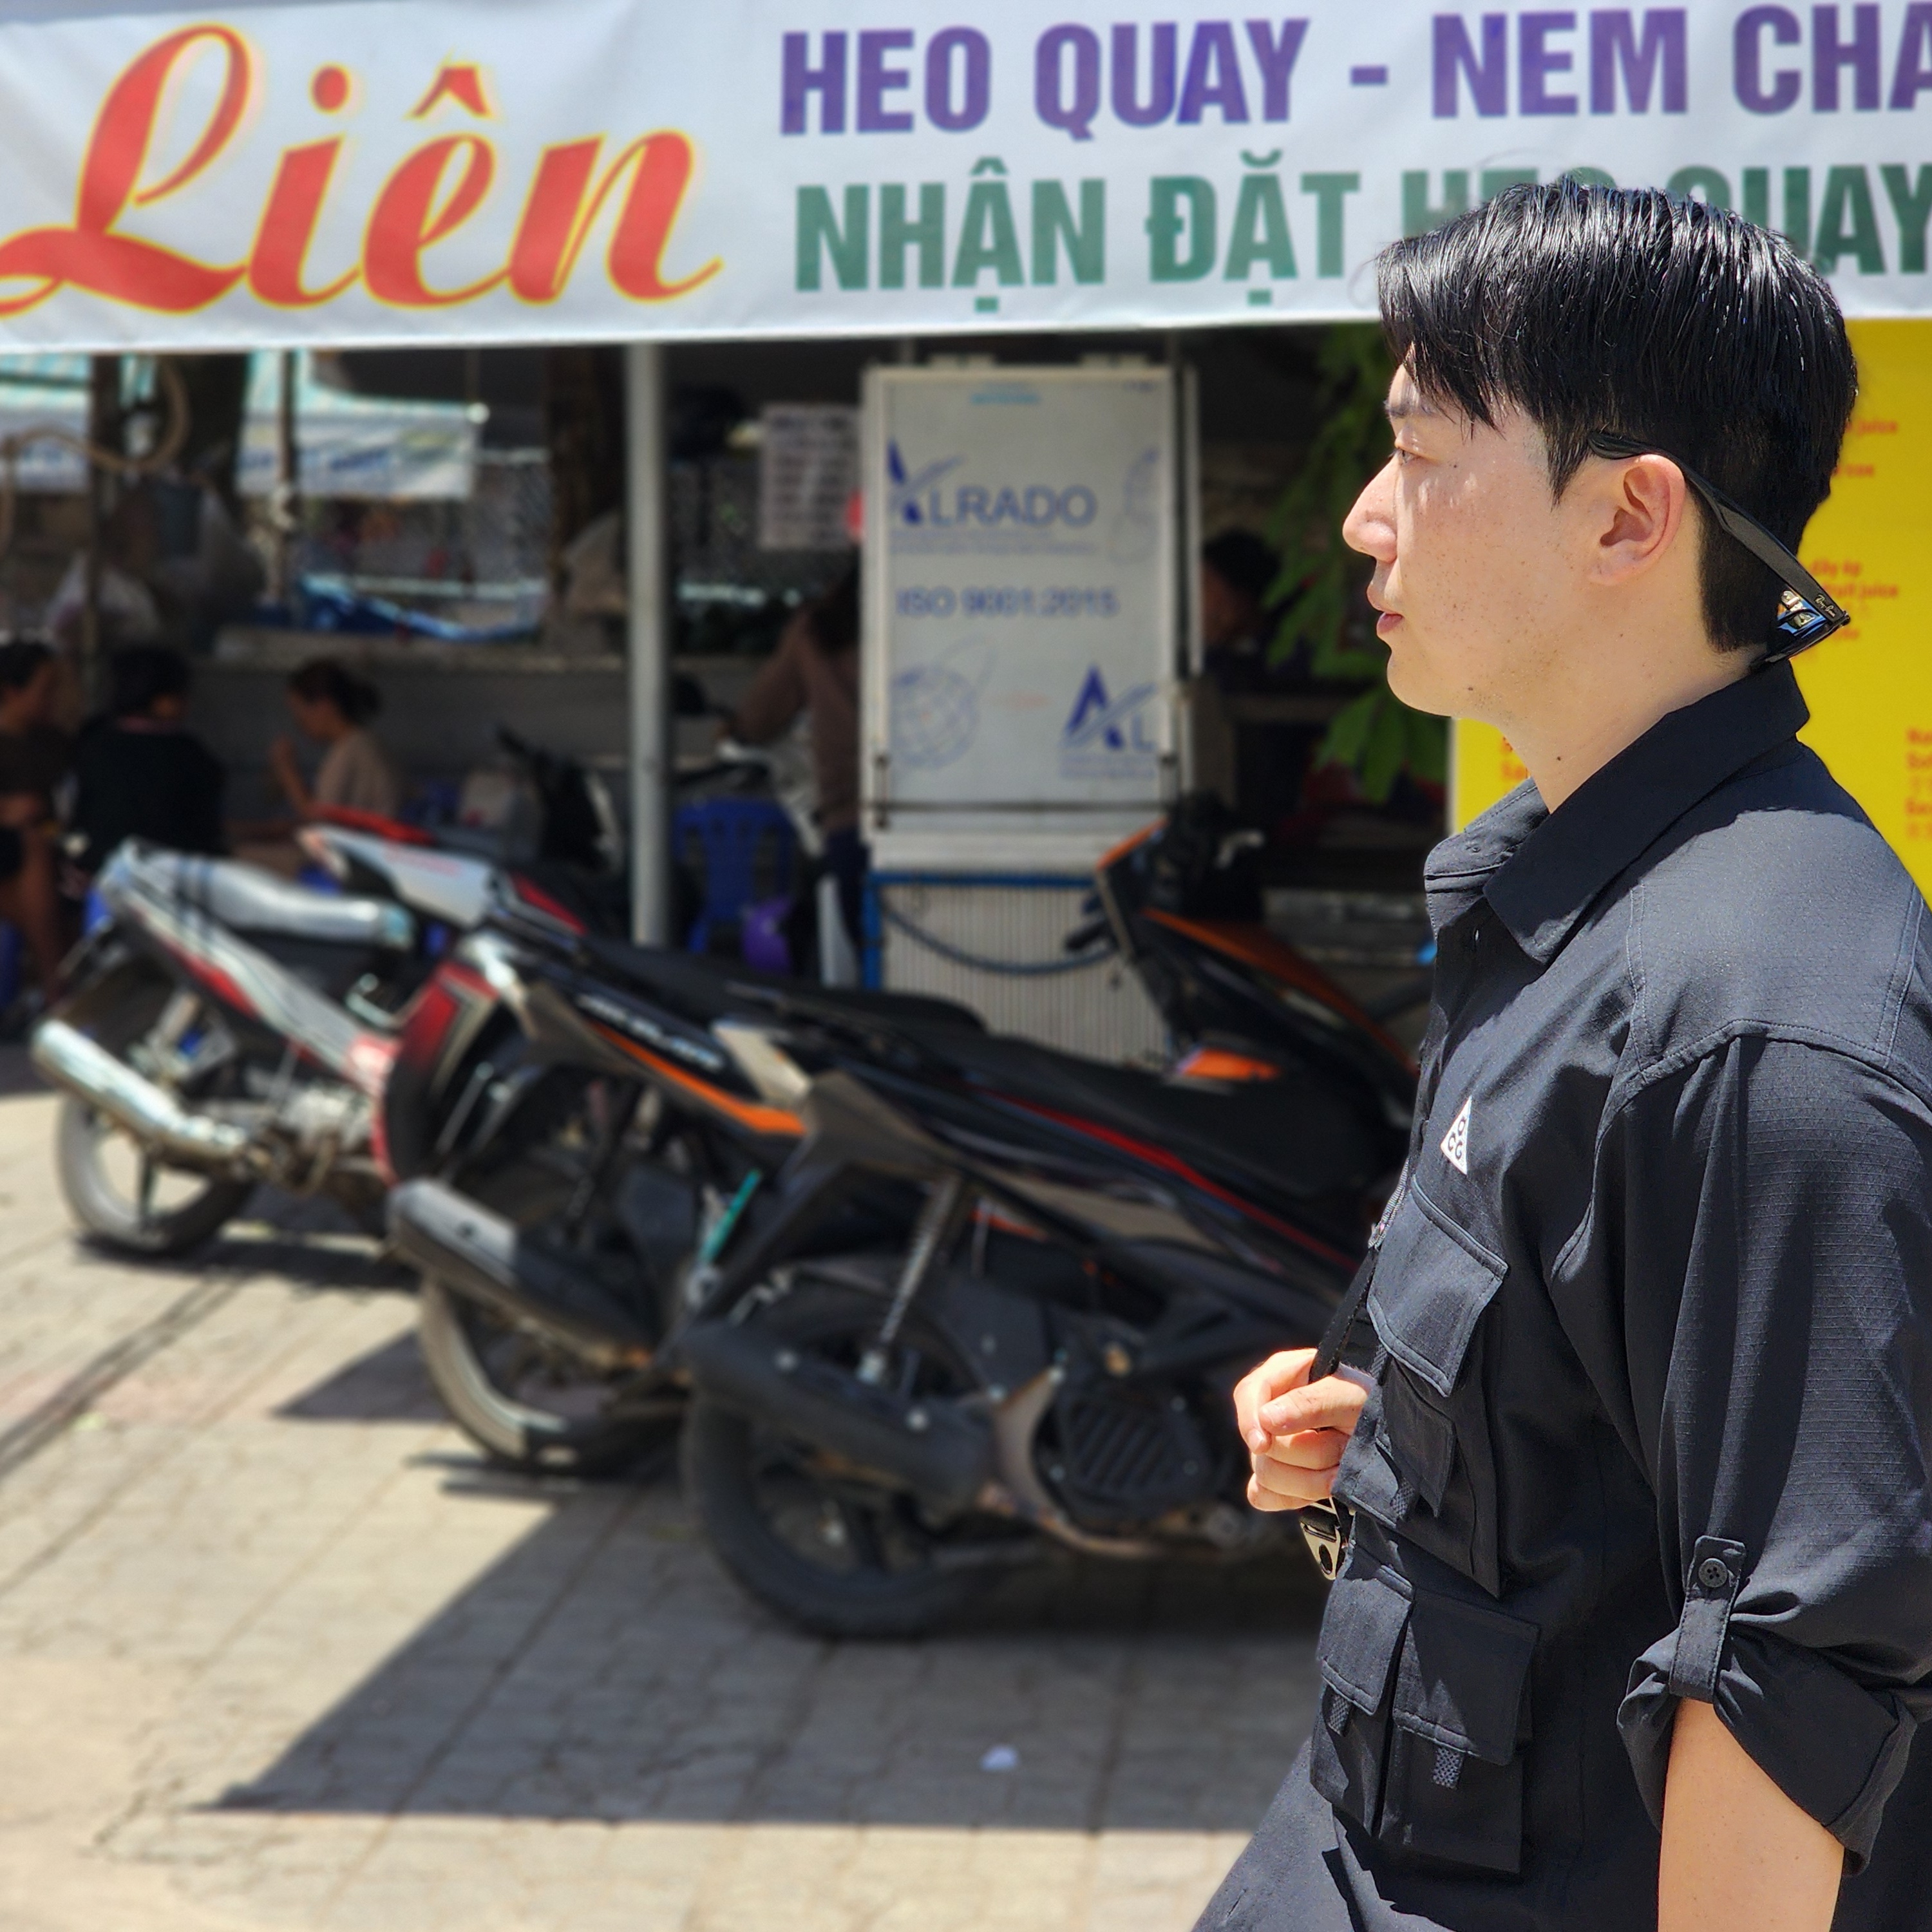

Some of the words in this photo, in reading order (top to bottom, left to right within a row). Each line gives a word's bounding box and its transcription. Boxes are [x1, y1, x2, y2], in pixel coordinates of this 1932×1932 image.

[781, 26, 991, 135] HEO
[1034, 18, 1310, 142] QUAY
[1432, 8, 1687, 118] NEM
[0, 24, 723, 316] Liên
[795, 156, 1106, 313] NHẬN
[1145, 149, 1360, 307] ĐẶT
